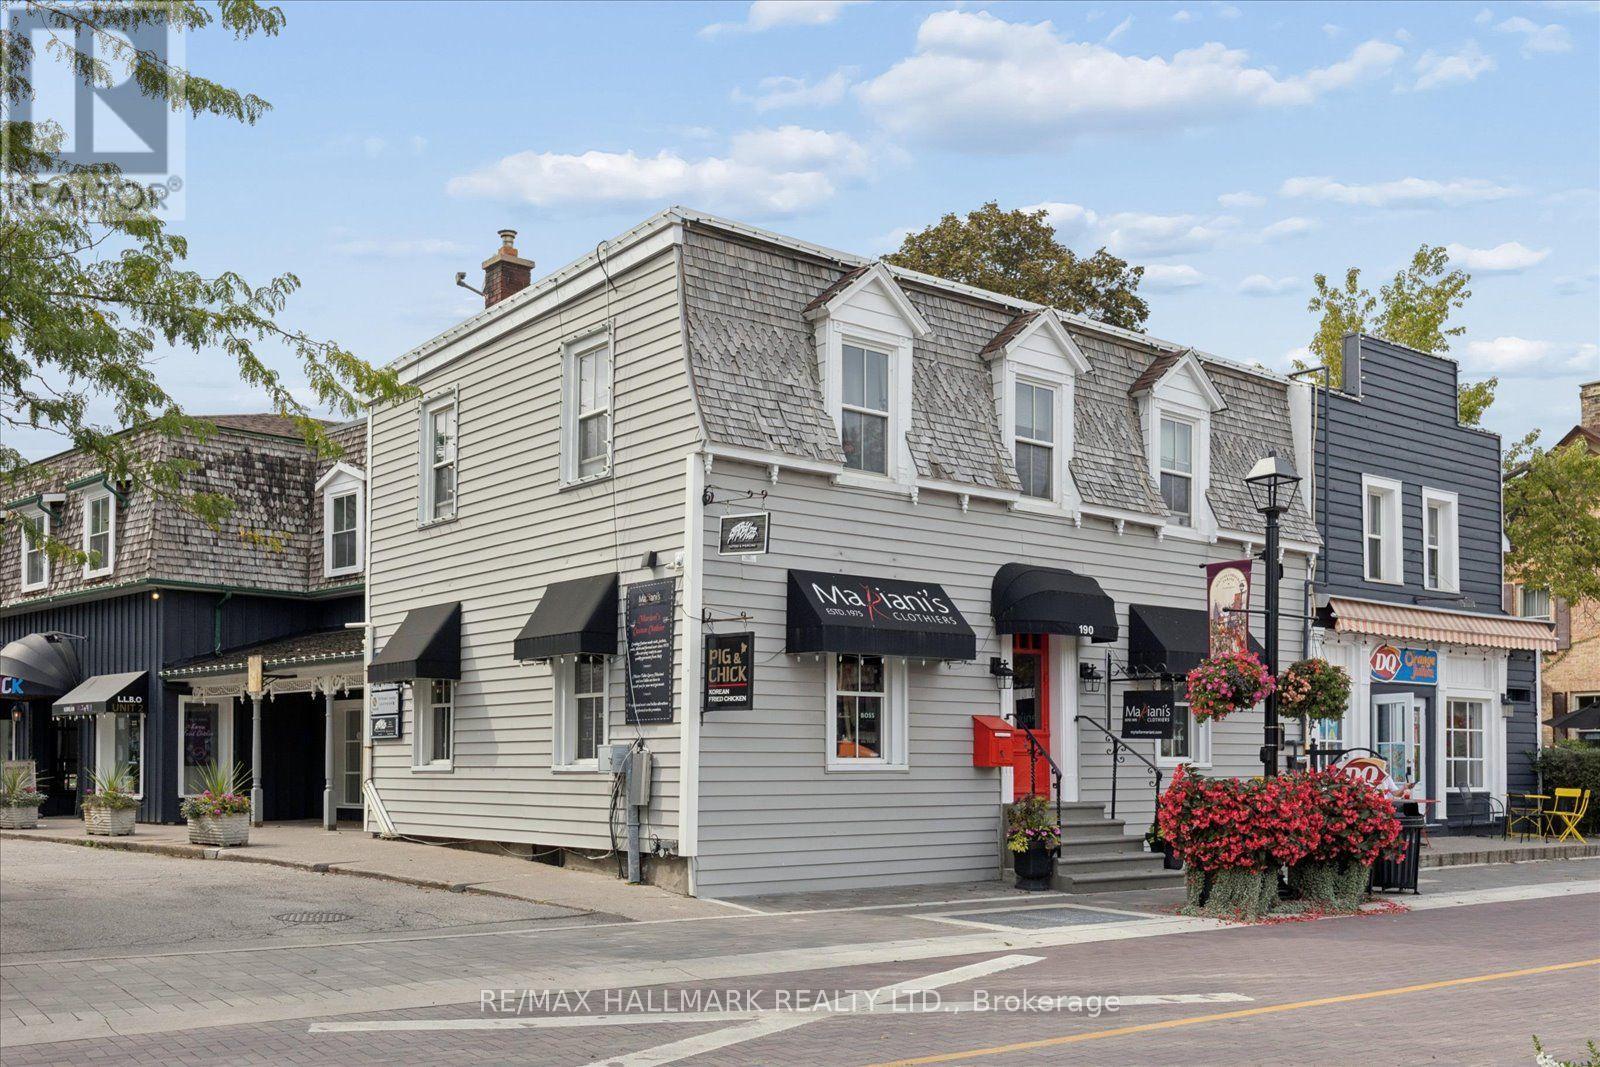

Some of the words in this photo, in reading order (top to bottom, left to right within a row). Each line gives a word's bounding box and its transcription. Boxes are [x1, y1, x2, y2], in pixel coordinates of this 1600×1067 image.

[892, 612, 957, 625] CLOTHIERS
[1079, 625, 1094, 635] 190
[708, 648, 731, 665] PIG
[733, 652, 742, 664] &
[1375, 653, 1397, 675] DQ
[708, 666, 747, 682] CHICK
[112, 703, 134, 712] UNIT
